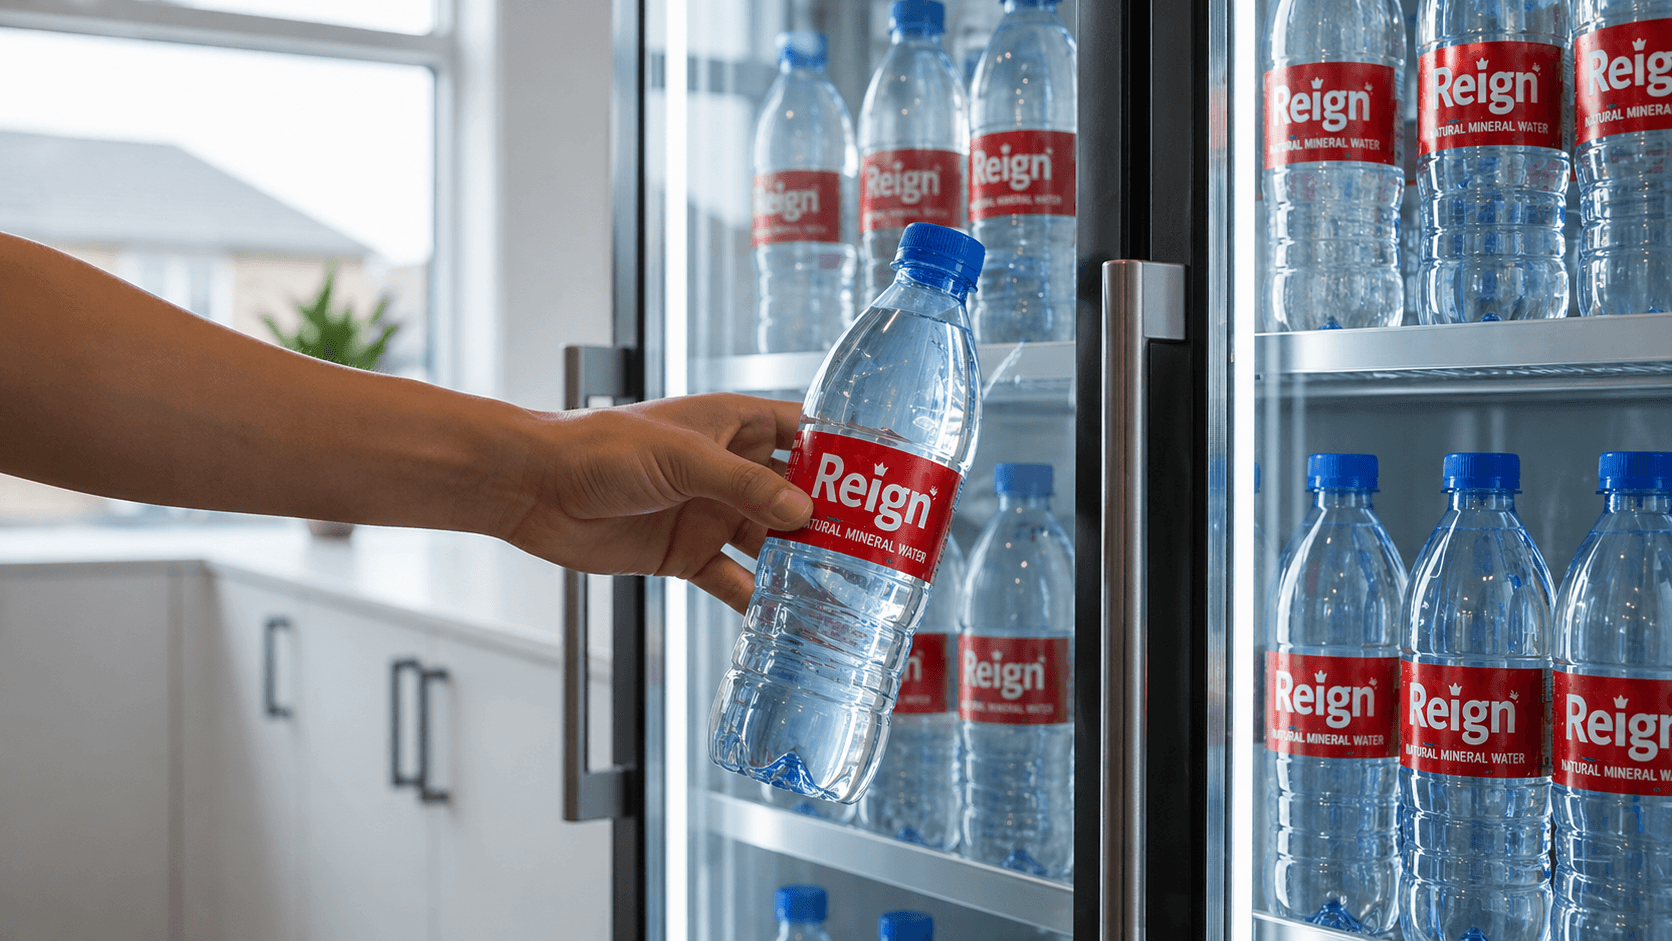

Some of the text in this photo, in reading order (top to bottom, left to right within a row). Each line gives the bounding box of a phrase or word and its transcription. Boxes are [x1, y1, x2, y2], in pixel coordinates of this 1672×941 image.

[1273, 77, 1370, 132] Reign
[1434, 57, 1538, 115] Reign
[1468, 121, 1516, 133] MINERAL
[1517, 121, 1549, 134] WATER
[1584, 109, 1625, 127] NATURAL
[973, 143, 1052, 191] Reign
[1304, 138, 1349, 150] MINERAL
[1350, 138, 1380, 151] WATER
[866, 161, 941, 204] Reign
[811, 452, 931, 531] Reign
[803, 518, 927, 564] ATURAL MINERAL WATER
[964, 649, 1045, 699] Reign
[1275, 669, 1375, 729] Reign
[1409, 682, 1516, 746] Reign
[1306, 732, 1351, 746] MINERAL
[1352, 734, 1384, 746] WATER
[1405, 743, 1525, 764] NATURAL MINERAL WATER
[1561, 758, 1601, 777] NATURAL
[1604, 765, 1657, 781] MINERAL
